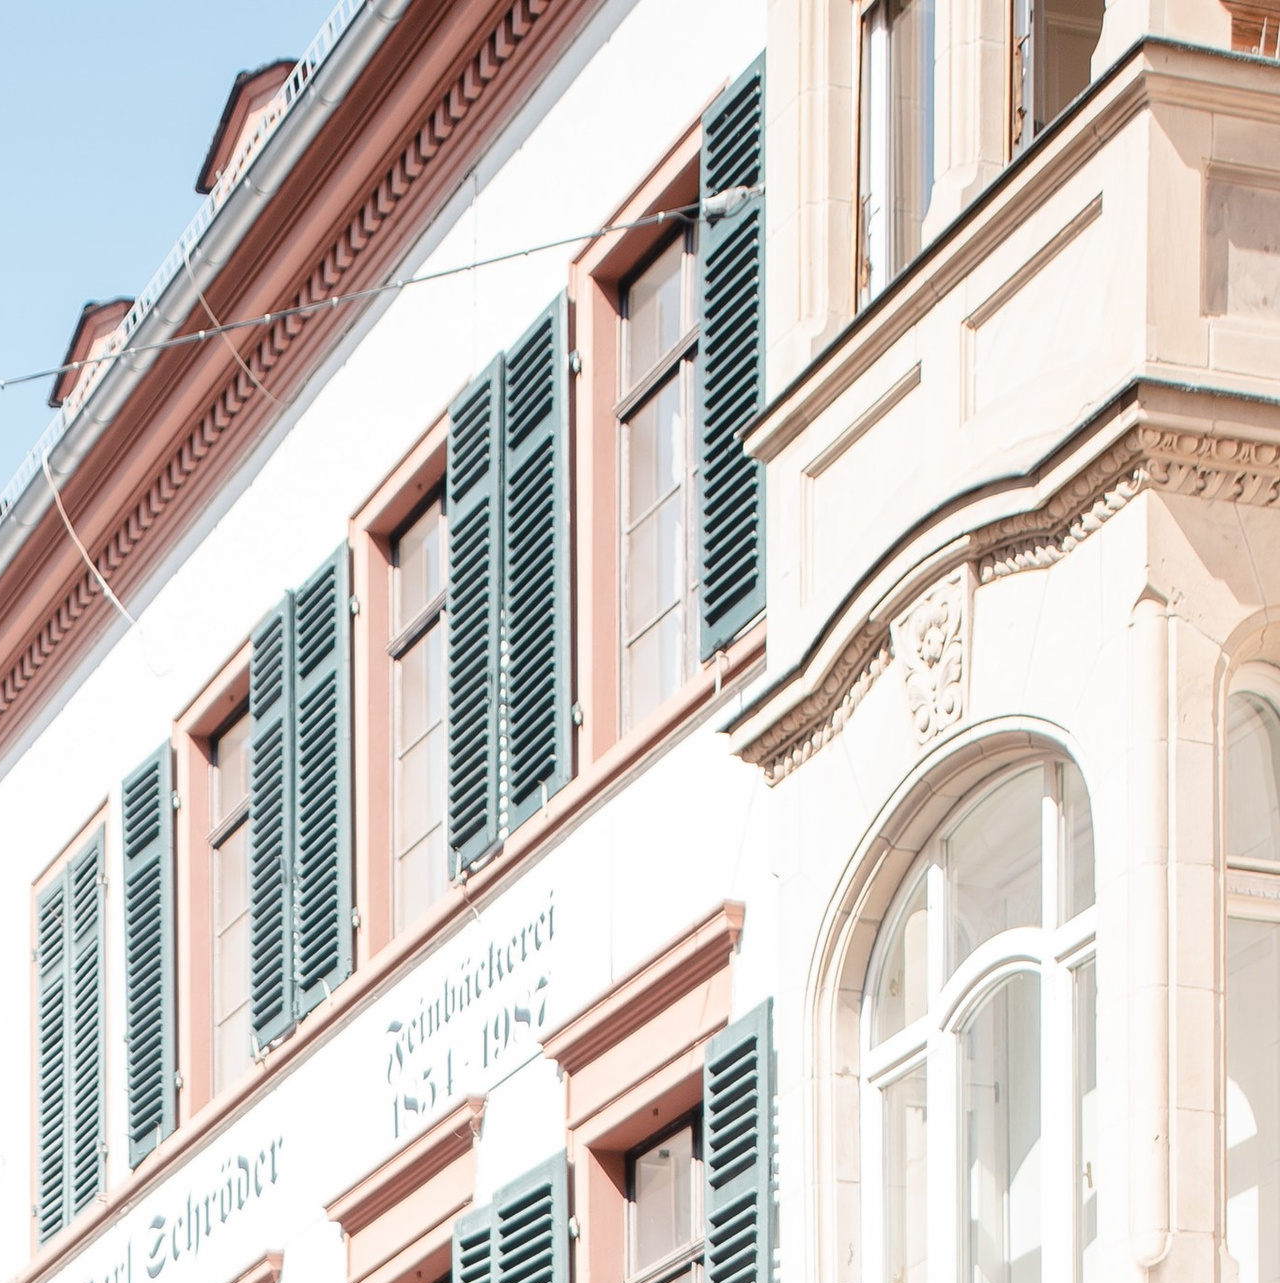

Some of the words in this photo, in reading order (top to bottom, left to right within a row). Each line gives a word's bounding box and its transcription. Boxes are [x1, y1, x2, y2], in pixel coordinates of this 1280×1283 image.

[386, 888, 555, 1085] Feinbäckerei
[483, 970, 551, 1069] 1987
[145, 1134, 284, 1279] Schröder
